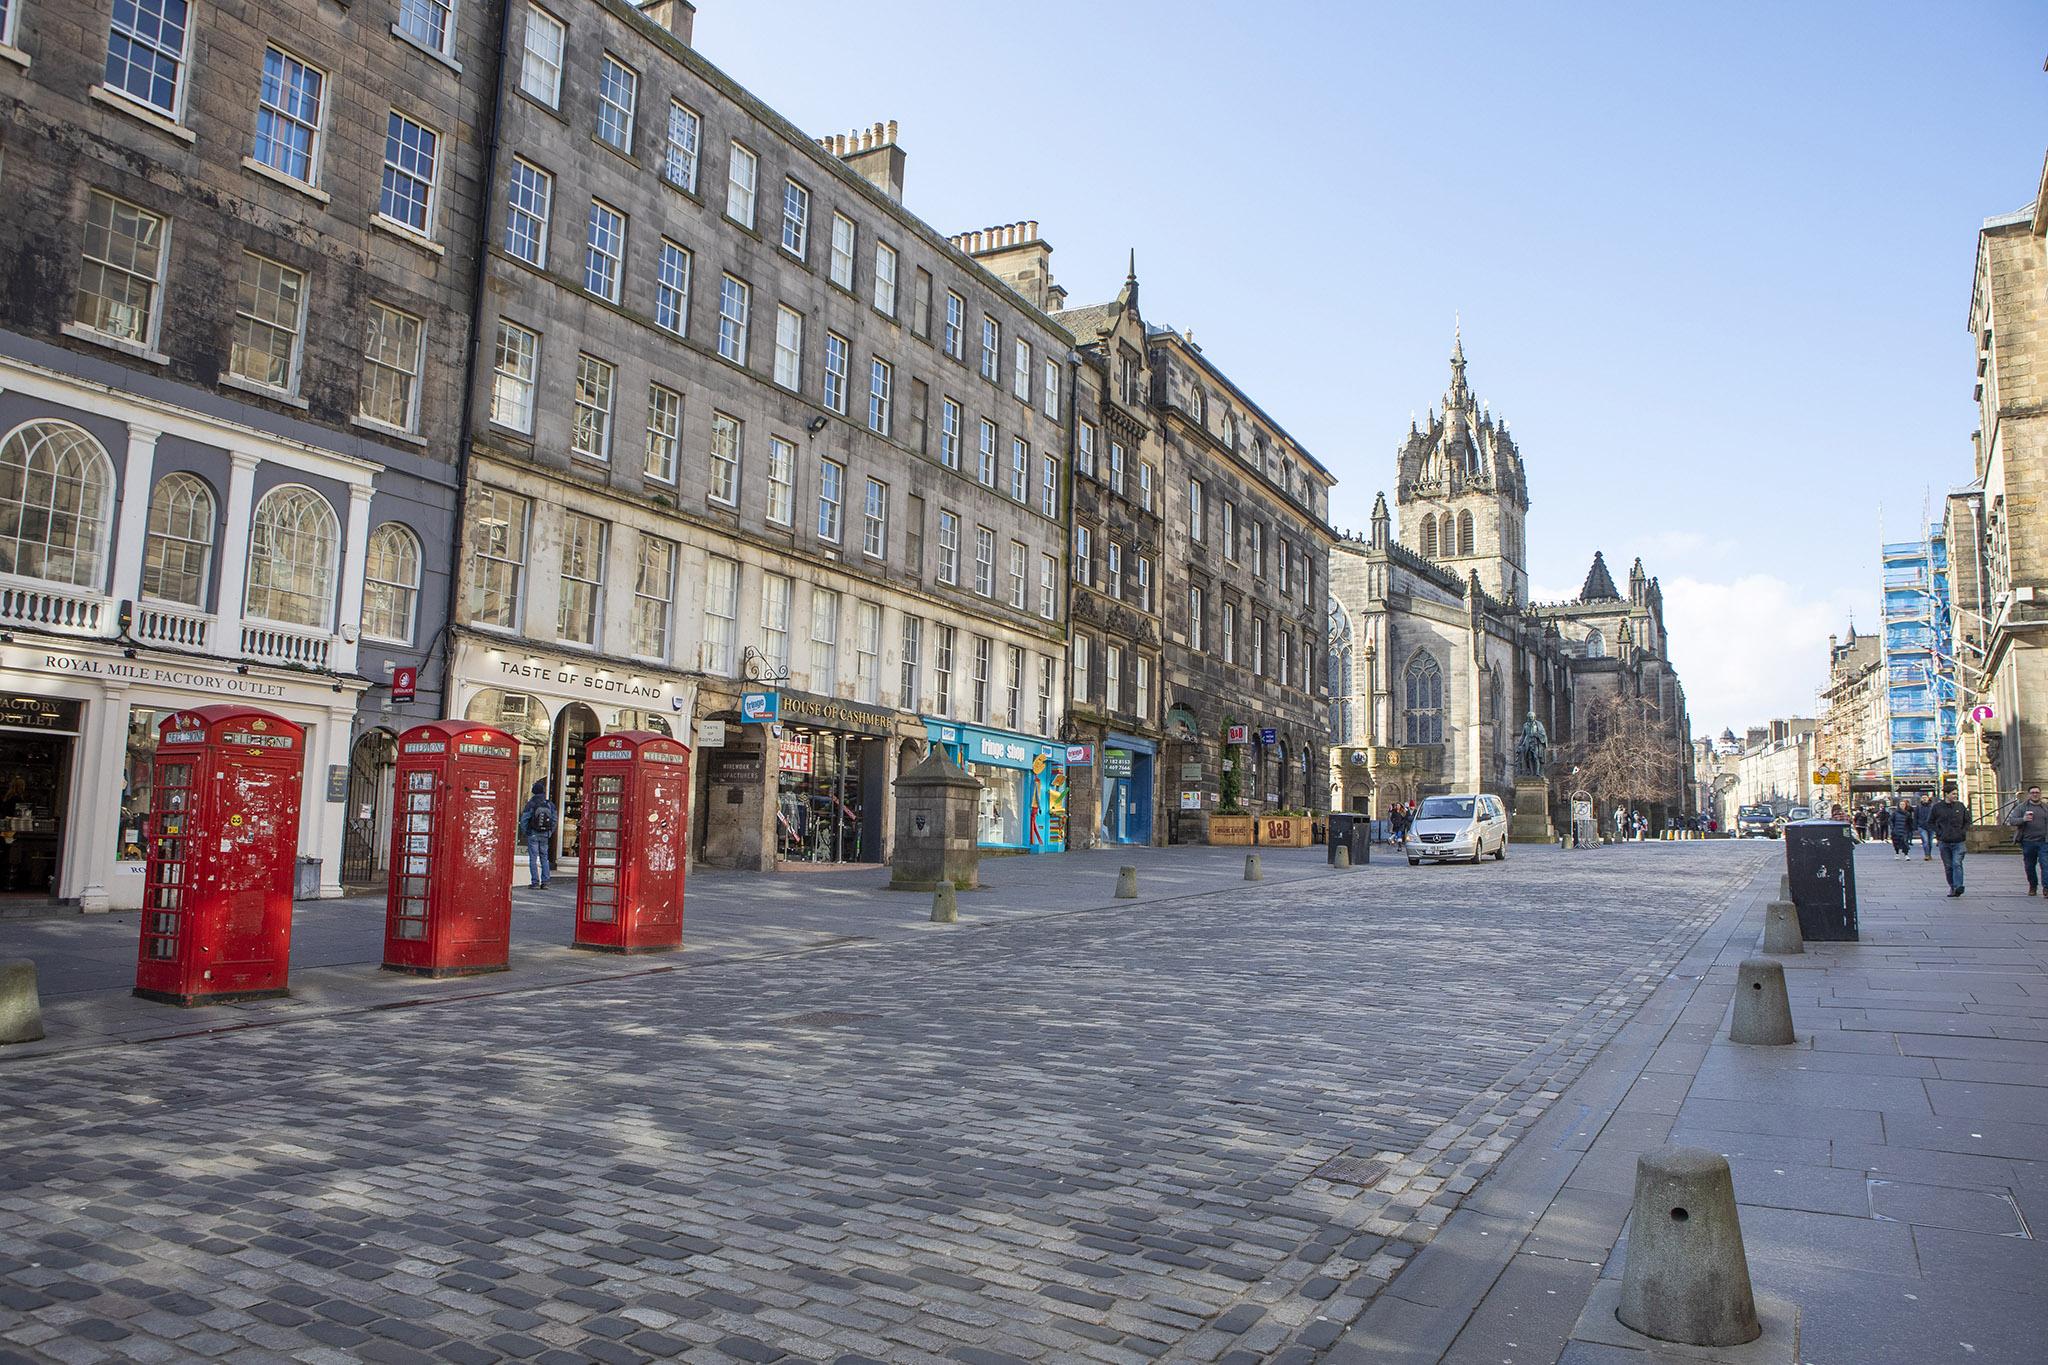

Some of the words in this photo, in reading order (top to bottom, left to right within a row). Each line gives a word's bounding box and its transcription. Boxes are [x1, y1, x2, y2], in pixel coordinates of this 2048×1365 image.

[46, 656, 102, 673] ROYAL
[107, 664, 149, 679] MILE
[155, 670, 224, 688] FACTORY
[227, 680, 286, 696] OUTLET
[500, 662, 551, 680] TASTE
[558, 672, 578, 684] OF
[583, 676, 661, 699] SCOTLAND
[783, 698, 821, 716] HOUSE
[823, 704, 839, 719] OF
[840, 708, 892, 728] CASHMERE
[594, 752, 631, 760] TELEPHONE
[780, 743, 808, 754] LEARANCE
[981, 737, 1005, 760] fringe
[1006, 743, 1025, 762] shop
[779, 752, 808, 771] SALE
[1267, 820, 1291, 839] B&B
